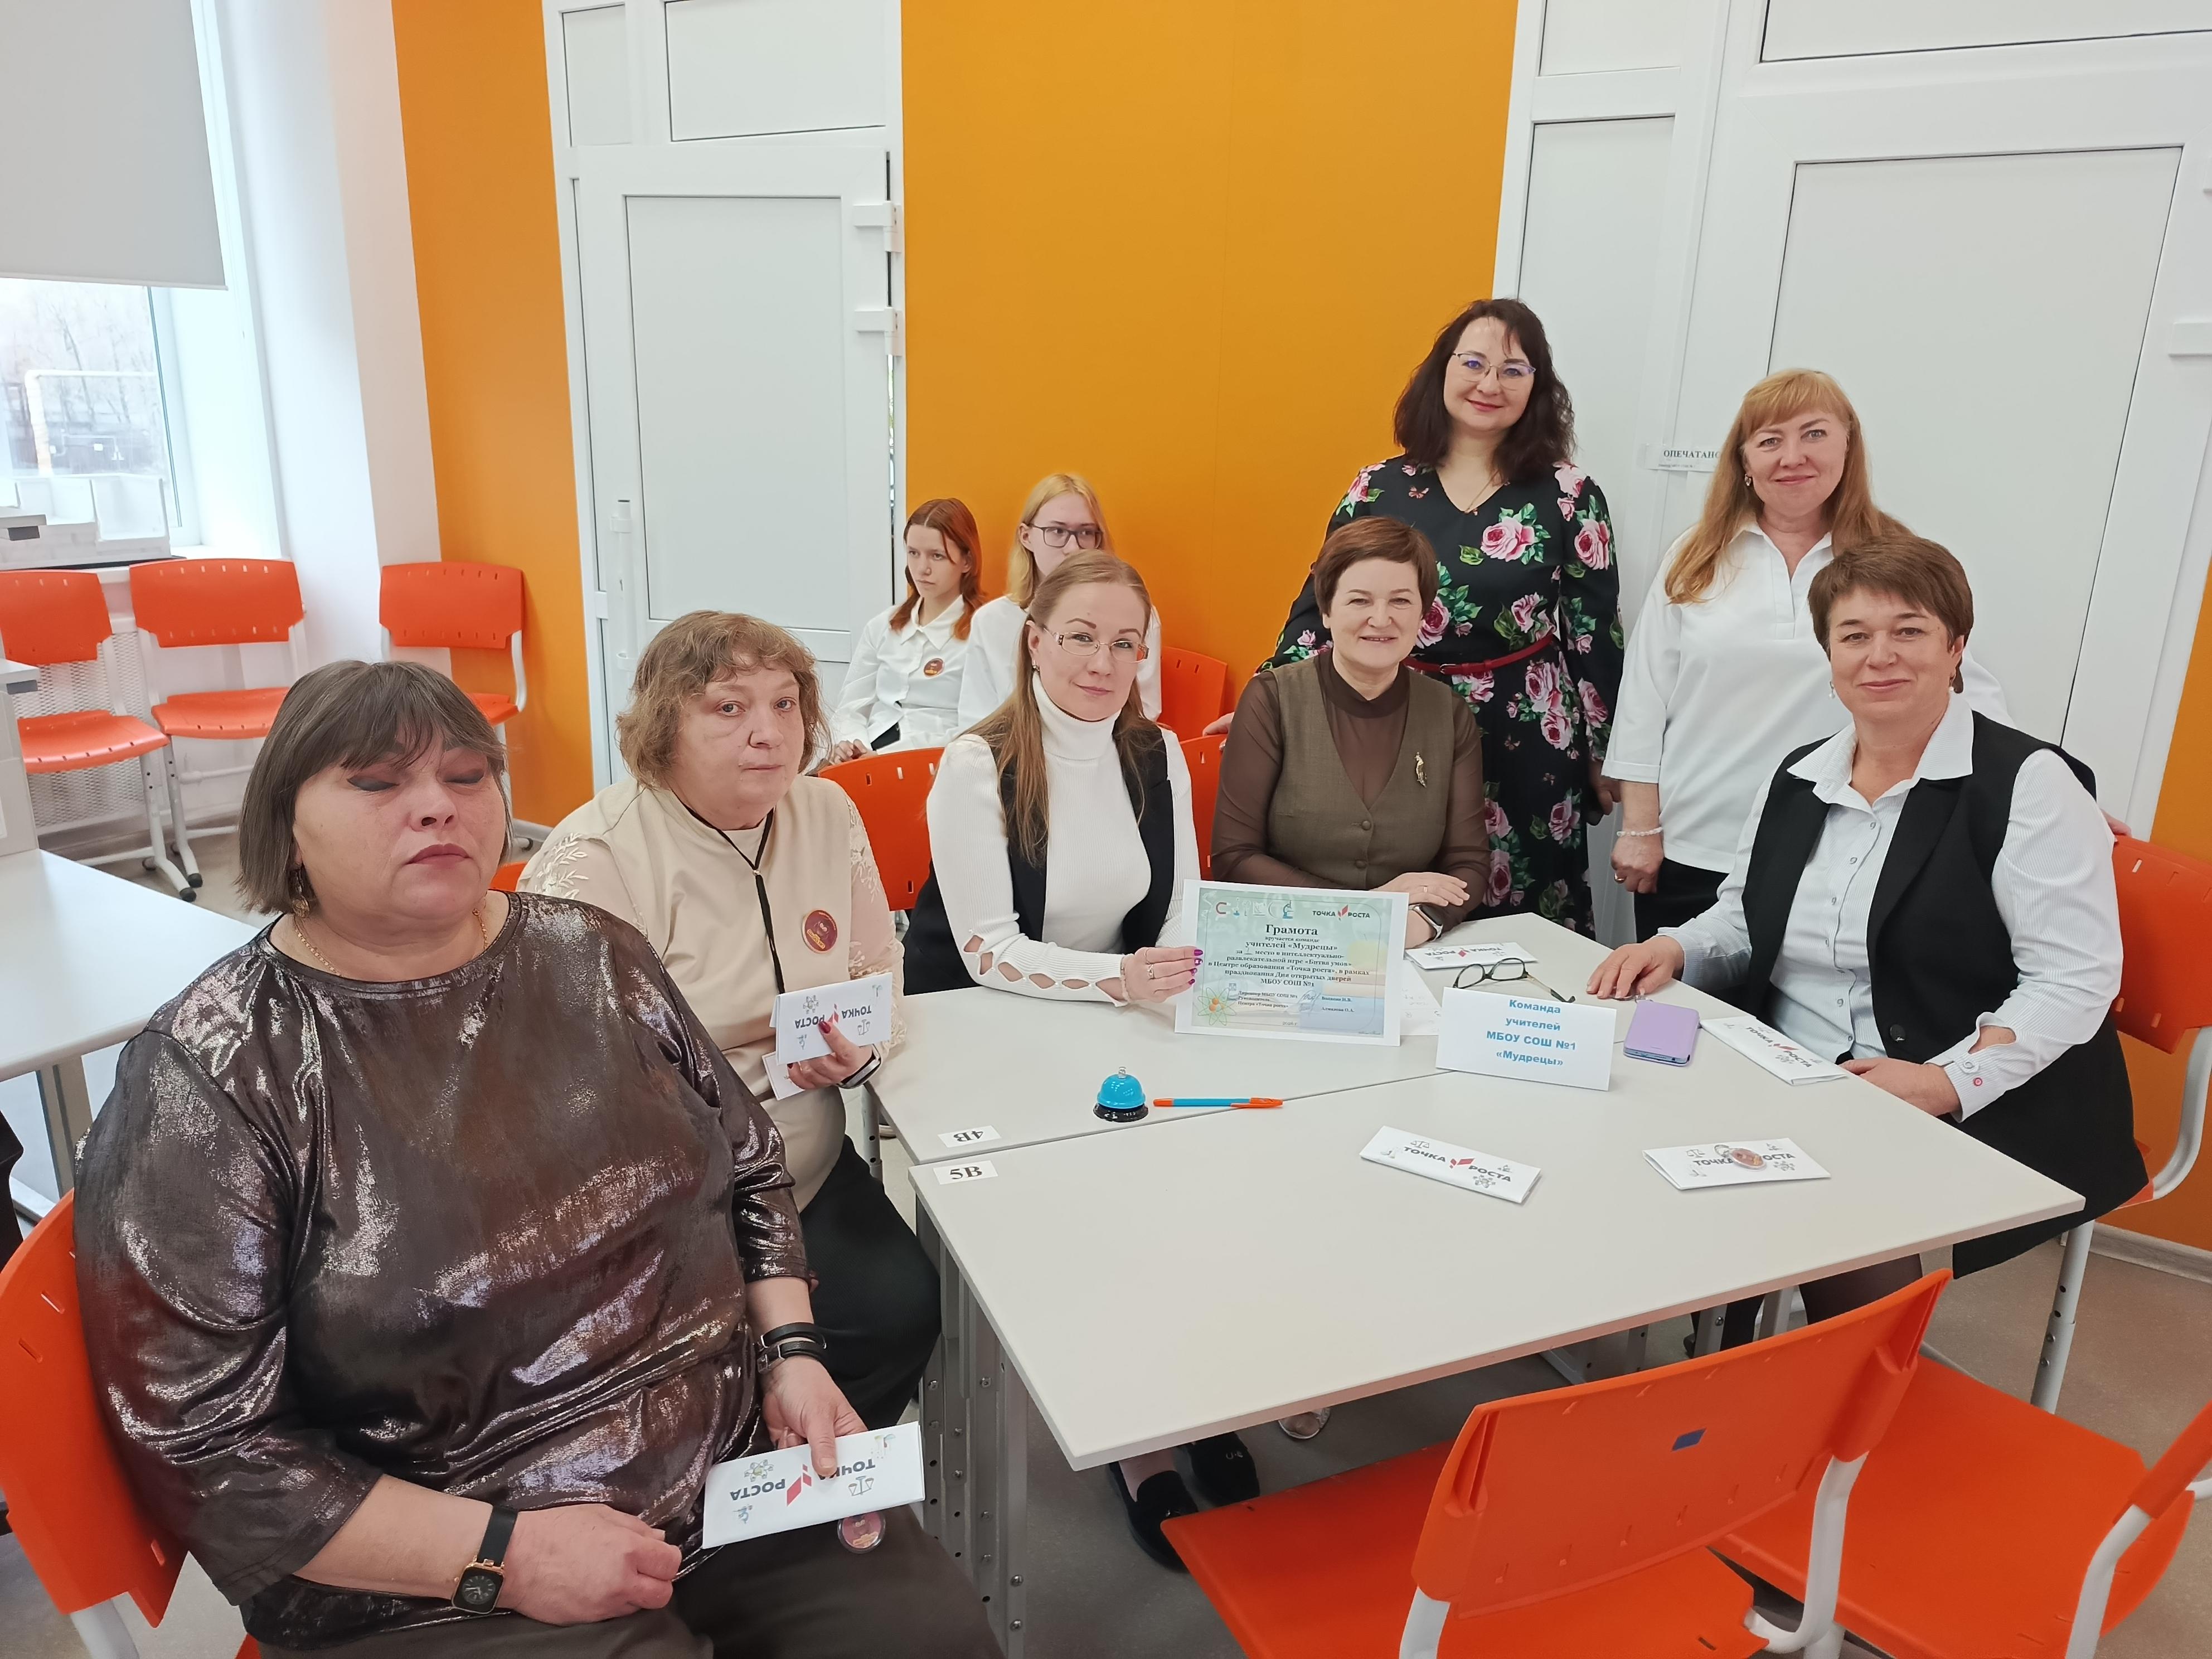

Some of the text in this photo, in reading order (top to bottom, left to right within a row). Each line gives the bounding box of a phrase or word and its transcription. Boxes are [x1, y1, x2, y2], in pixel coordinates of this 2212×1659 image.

[1266, 924, 1318, 935] Грамота
[1288, 943, 1338, 951] «Мудрецы»
[1509, 1000, 1561, 1014] Команда
[795, 1005, 872, 1029] ТОЧКА РОСТА
[1505, 1017, 1561, 1031] учителей
[1486, 1031, 1576, 1050] МБОУ СОШ №1
[1746, 1027, 1812, 1068] ТОЧКА РОСТА
[1496, 1050, 1564, 1066] «Мудрецы»
[1404, 1146, 1511, 1182] ТОЧКА РОСТА
[1693, 1157, 1734, 1166] ТОЧКА
[730, 1478, 785, 1501] РОСТА
